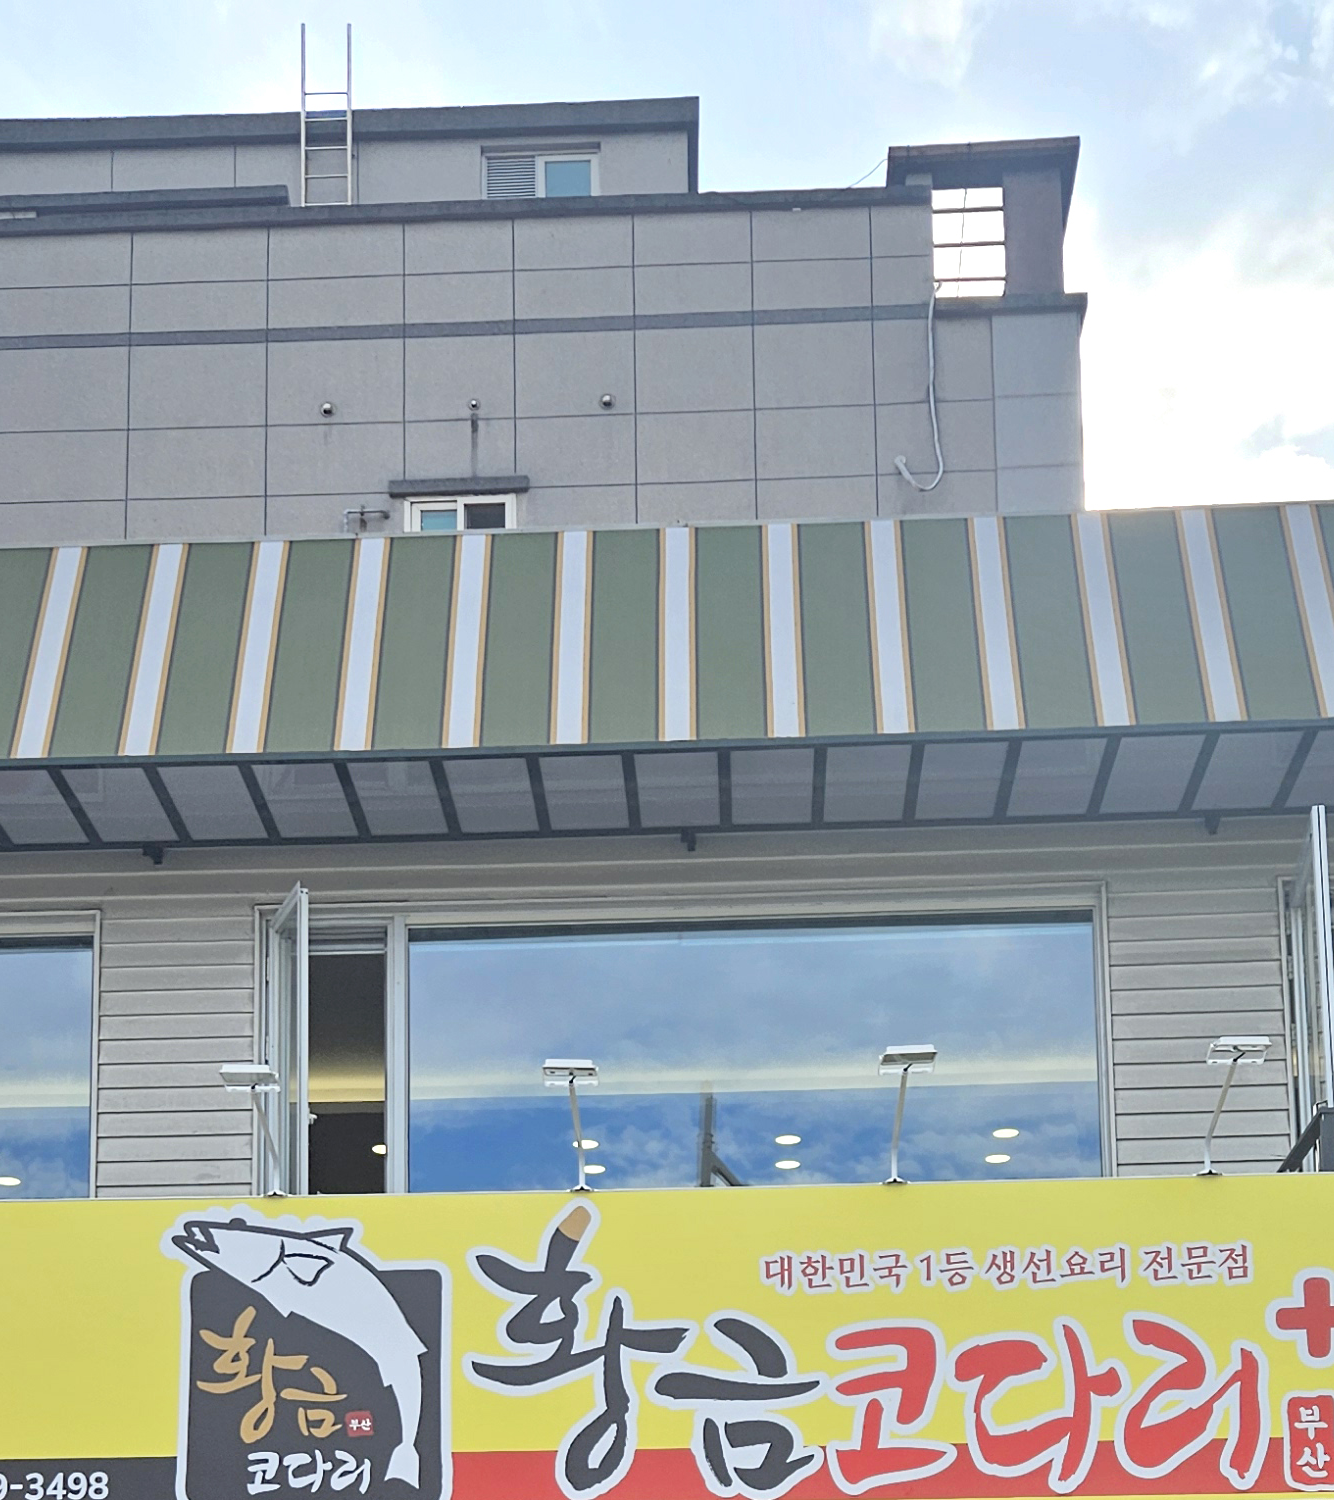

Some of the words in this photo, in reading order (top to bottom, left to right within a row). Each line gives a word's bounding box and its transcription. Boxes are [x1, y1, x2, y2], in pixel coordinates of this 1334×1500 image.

[764, 1252, 908, 1290] 대한민국
[919, 1250, 972, 1287] 1등
[984, 1246, 1127, 1285] 생선요리
[1141, 1243, 1252, 1283] 전문점
[196, 1306, 348, 1443] 황금
[349, 1418, 371, 1431] 부산
[1291, 1402, 1331, 1480] 부산
[246, 1449, 371, 1494] 코다리
